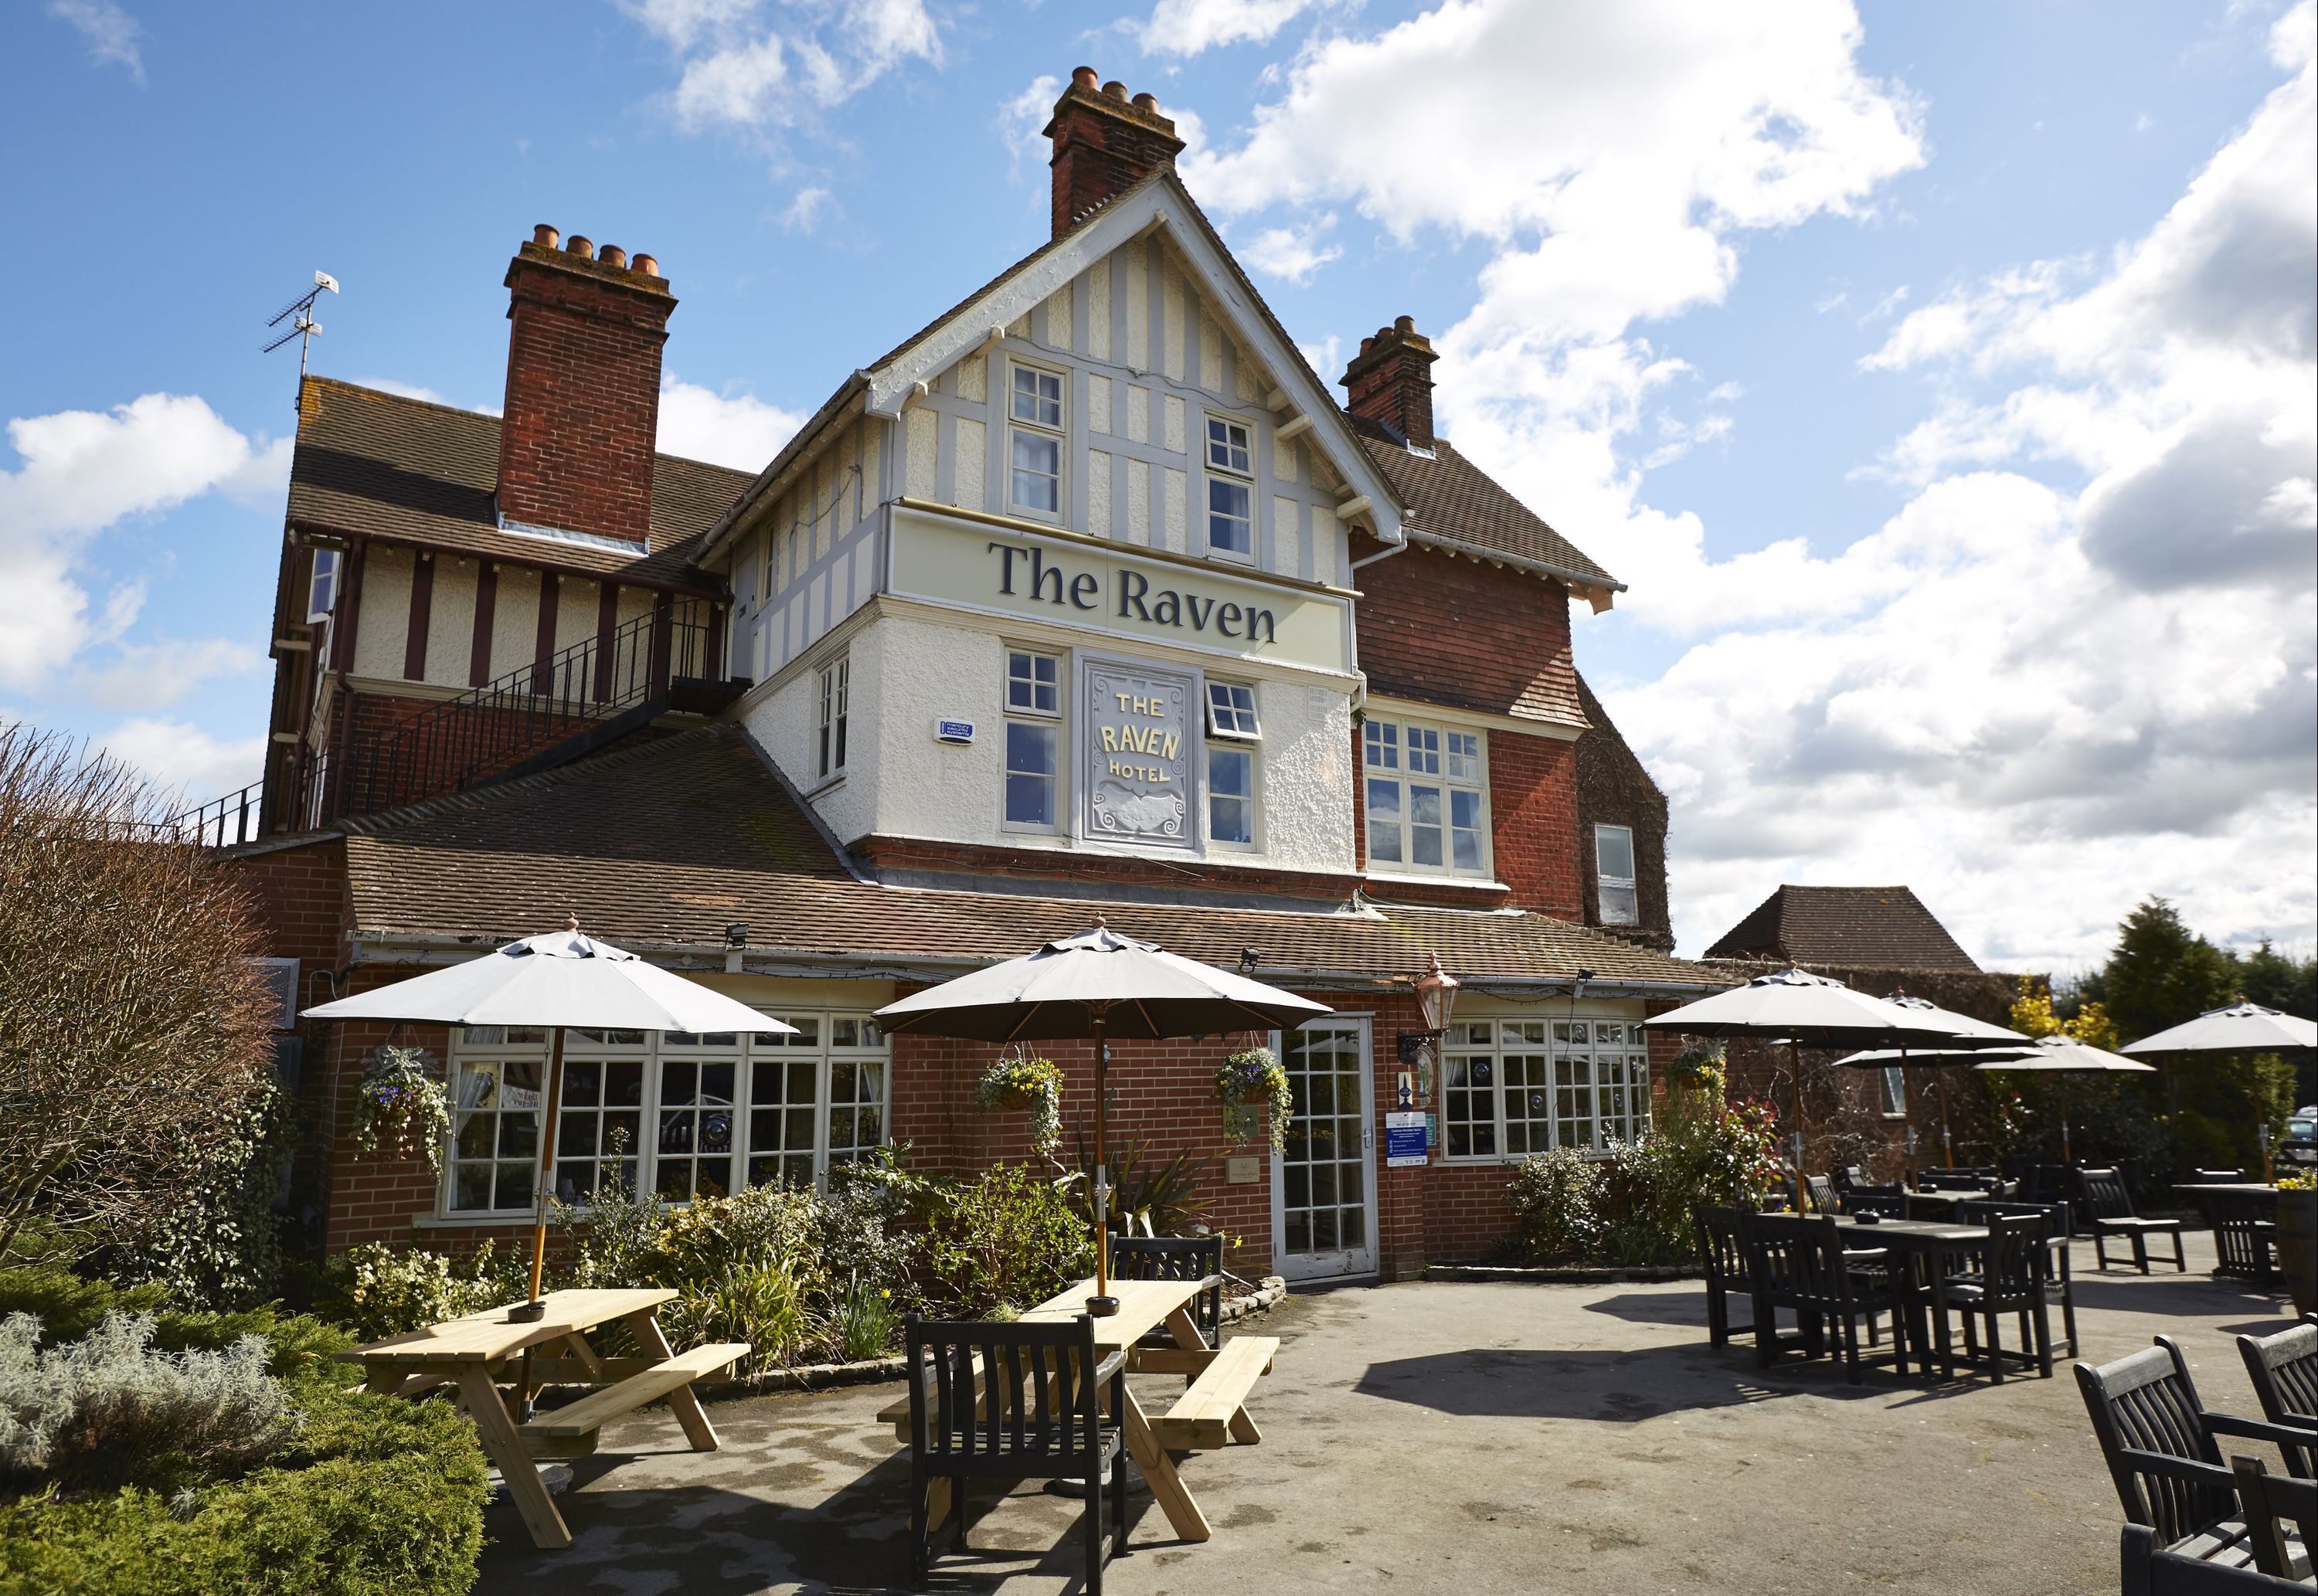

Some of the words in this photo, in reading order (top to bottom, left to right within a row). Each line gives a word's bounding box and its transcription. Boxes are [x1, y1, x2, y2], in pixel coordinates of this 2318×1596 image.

[988, 542, 1100, 610] The
[1117, 569, 1278, 644] Raven
[1116, 693, 1164, 718] THE
[1101, 725, 1180, 761] RAVEN
[1110, 759, 1171, 783] HOTEL
